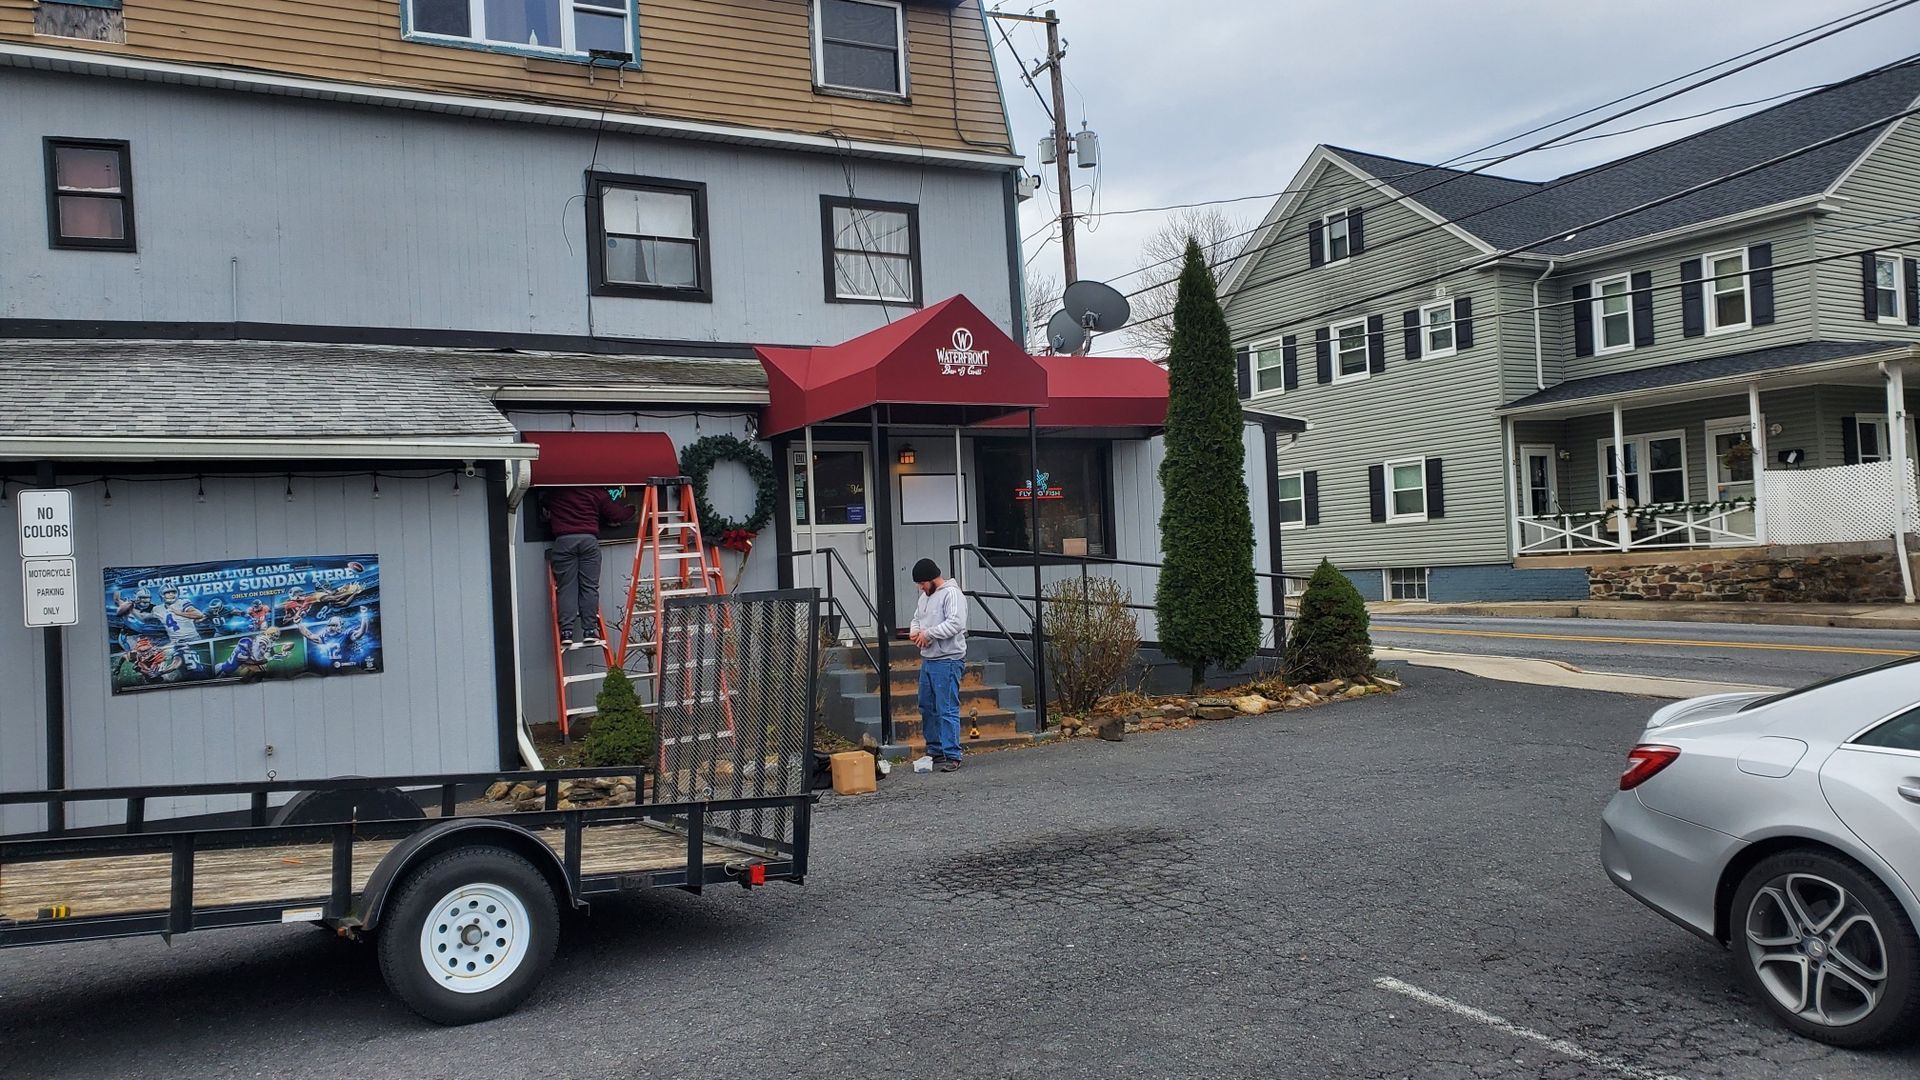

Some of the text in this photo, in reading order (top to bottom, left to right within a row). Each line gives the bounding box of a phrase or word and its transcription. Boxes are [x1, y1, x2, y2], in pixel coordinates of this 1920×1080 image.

[957, 332, 970, 350] W
[936, 347, 989, 365] WATERFRONT
[942, 364, 957, 375] Bar
[967, 365, 982, 375] Grill
[37, 507, 54, 520] NO
[23, 524, 69, 539] COLORS
[28, 568, 71, 578] MOTORCYCLE
[138, 576, 180, 589] CATCH
[183, 570, 224, 584] EVERY
[224, 568, 253, 579] LIVE
[255, 563, 294, 575] GAME.
[177, 567, 360, 598] EVERY SUNDAY HERE.
[37, 587, 65, 597] PARKING
[43, 606, 60, 616] ONLY
[166, 613, 180, 632] 4
[213, 616, 226, 627] 91
